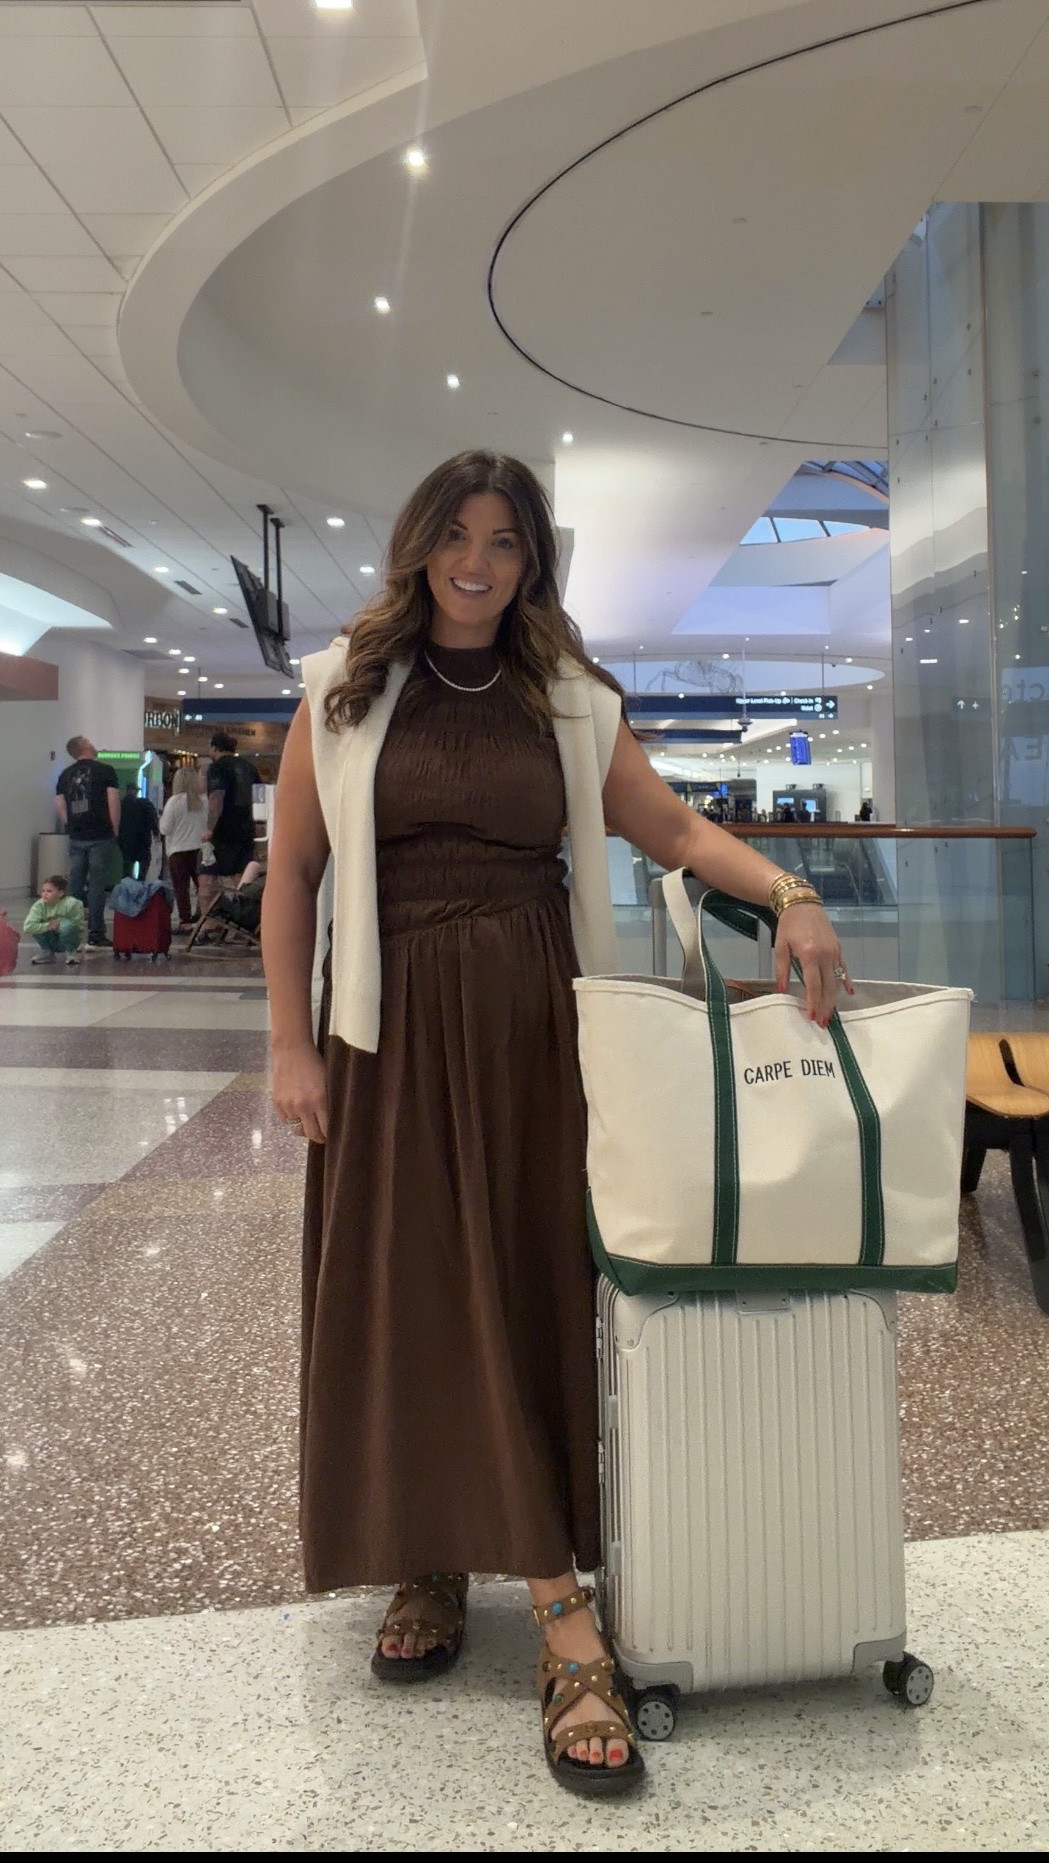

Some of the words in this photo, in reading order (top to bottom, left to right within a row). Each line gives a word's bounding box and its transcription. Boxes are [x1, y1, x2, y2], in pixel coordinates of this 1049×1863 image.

[144, 710, 178, 729] RBON
[744, 1060, 793, 1085] CARPE
[801, 1059, 836, 1078] DIEM
